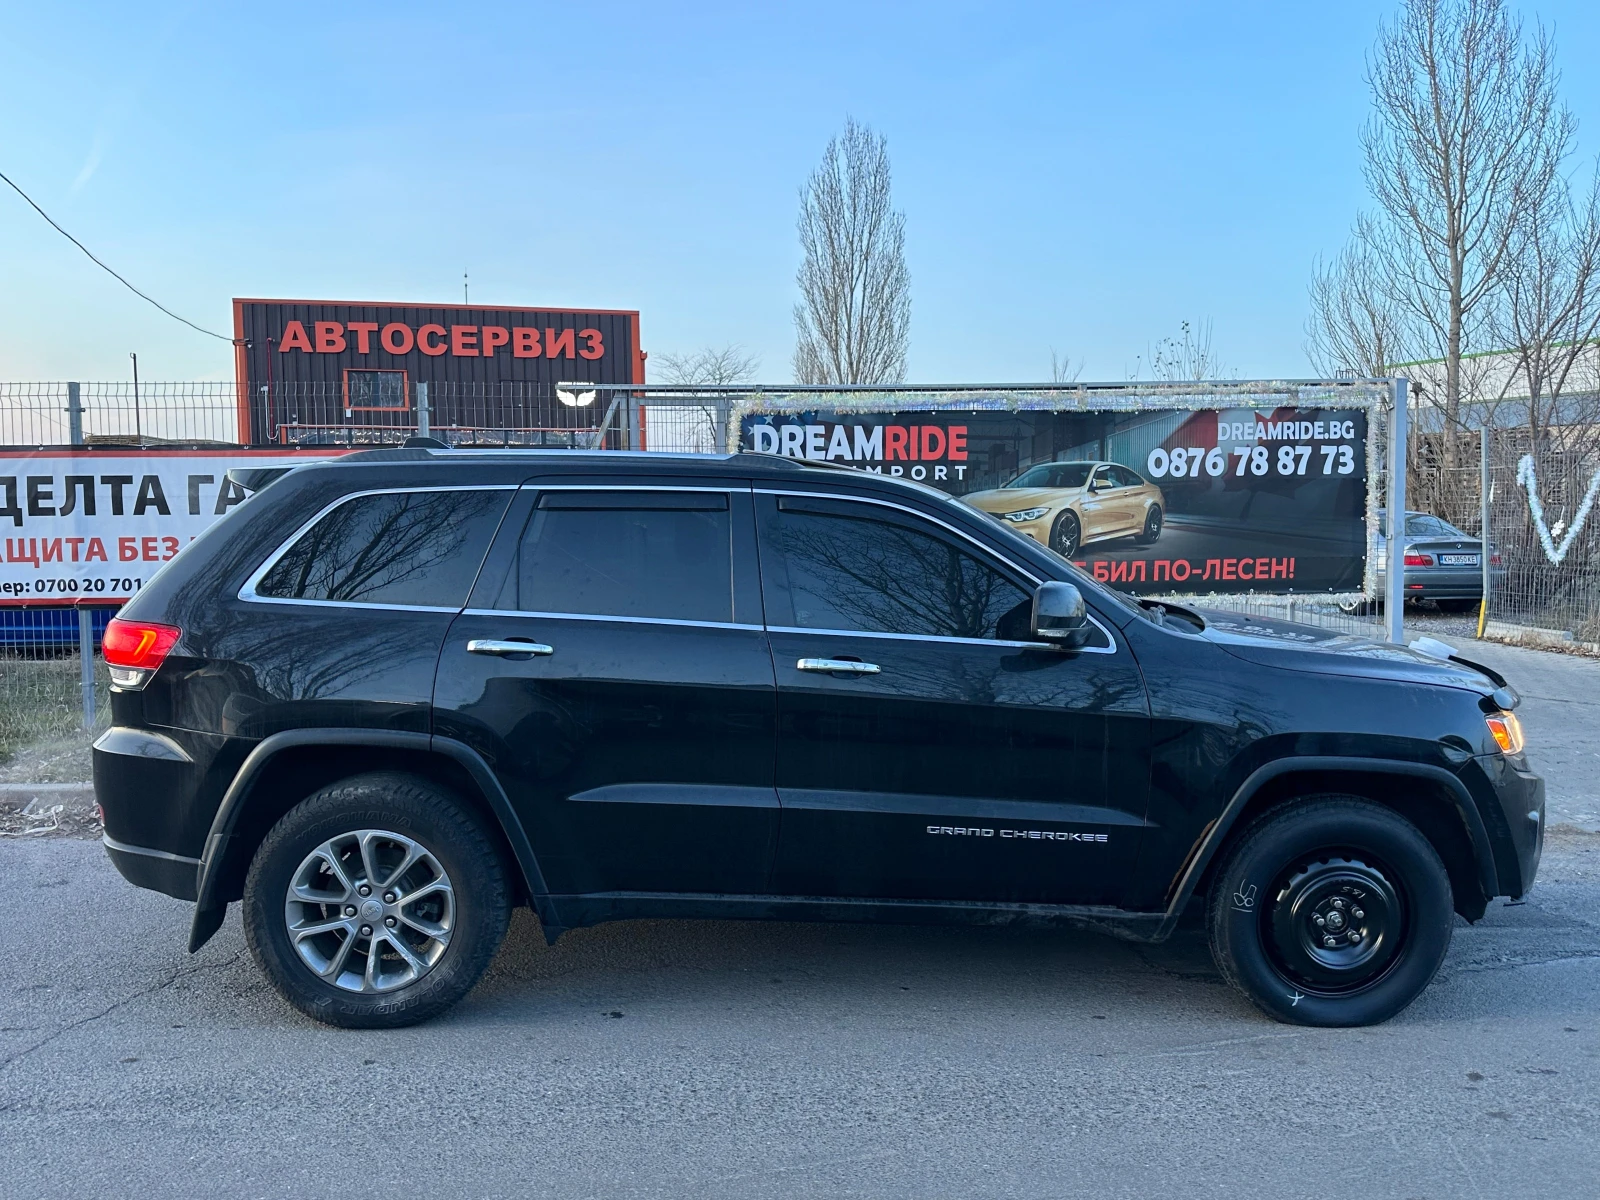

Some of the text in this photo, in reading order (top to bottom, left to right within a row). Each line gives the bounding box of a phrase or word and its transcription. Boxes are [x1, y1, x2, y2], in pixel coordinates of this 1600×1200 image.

[278, 320, 605, 360] АВТОСЕРВИЗ
[753, 424, 968, 461] DREAMRIDE
[1217, 421, 1355, 441] DREAMRIDE.BG
[852, 465, 967, 481] MPORT
[1147, 445, 1355, 478] 0876 78 87 73
[0, 536, 180, 568] ЩИТА БЕЗ
[1093, 560, 1146, 582] БИЛ
[1153, 557, 1295, 581] ПО-ЛЕСЕН!
[0, 582, 30, 596] ер:
[34, 579, 79, 593] 0700
[82, 578, 105, 592] 20
[926, 825, 1109, 842] GRAND CHEROKEE
